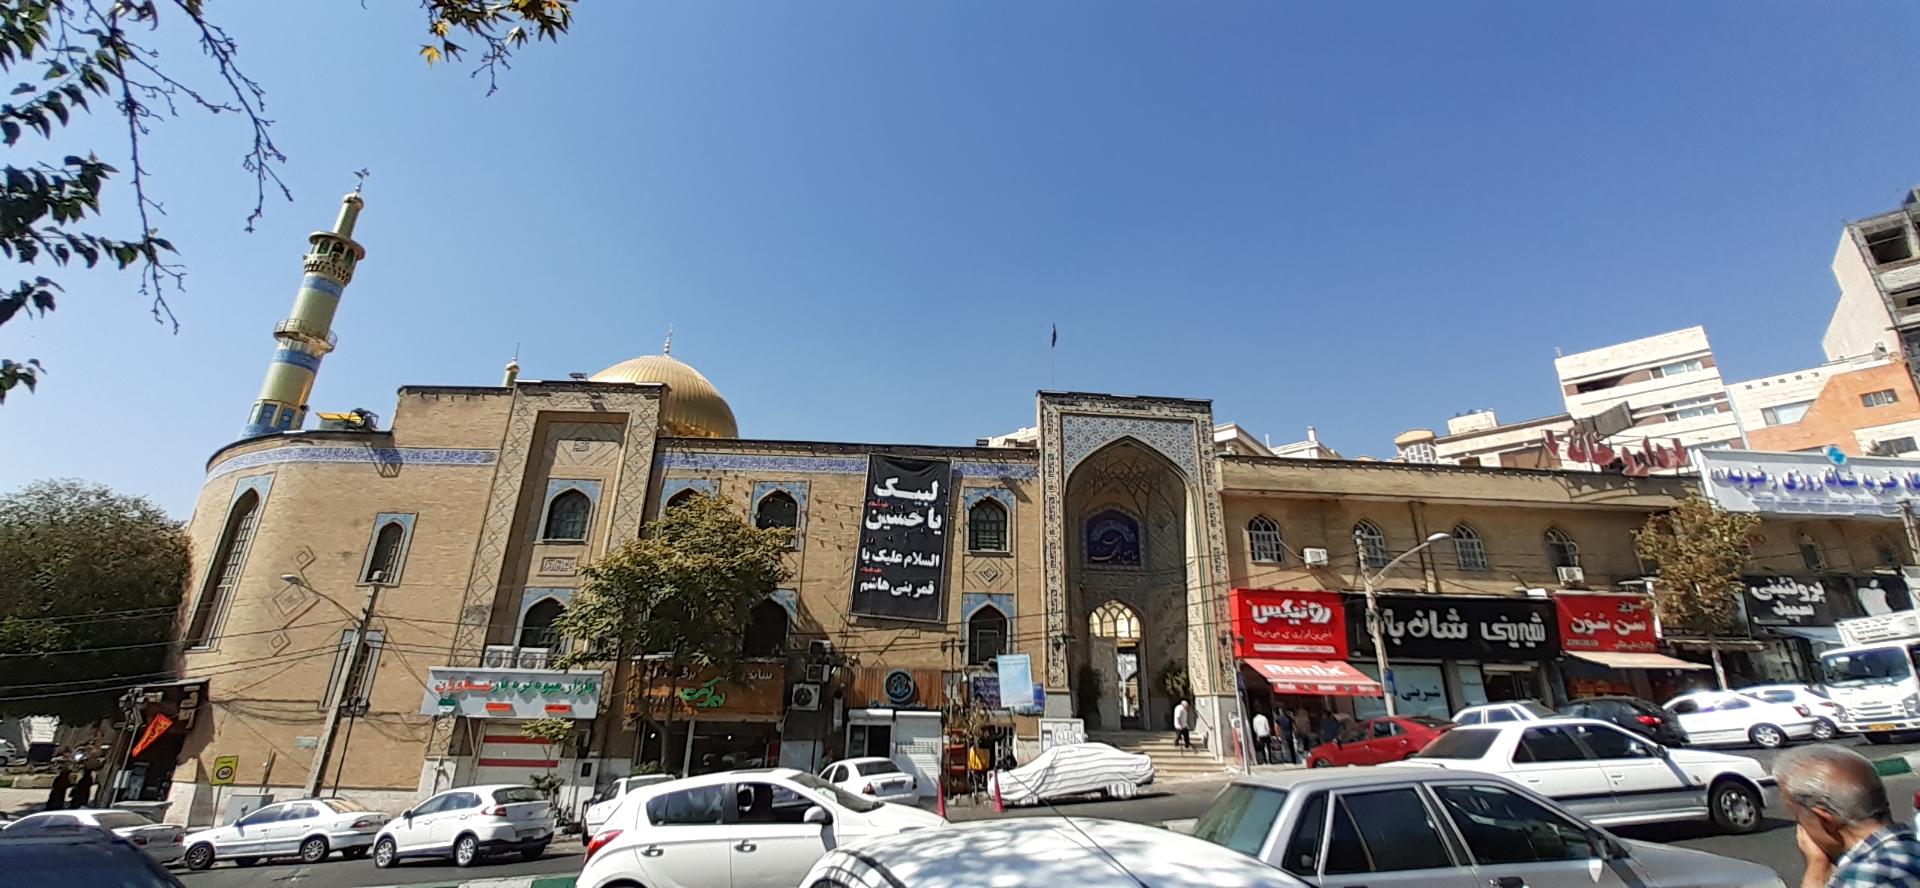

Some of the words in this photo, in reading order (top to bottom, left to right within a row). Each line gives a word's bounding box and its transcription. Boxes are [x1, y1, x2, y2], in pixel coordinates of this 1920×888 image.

[873, 477, 939, 506] لبیک
[865, 508, 925, 530] حسین
[927, 506, 942, 535] یا
[861, 547, 870, 564] یا
[871, 548, 902, 565] علیک
[903, 552, 940, 568] السلام
[859, 576, 890, 593] هاشم
[890, 580, 913, 597] بنی
[913, 580, 935, 598] قمر
[1252, 599, 1332, 625] رونیکس
[1407, 607, 1469, 640] شان
[1480, 611, 1546, 648] شیرینی
[1401, 686, 1441, 702] شیرینی
